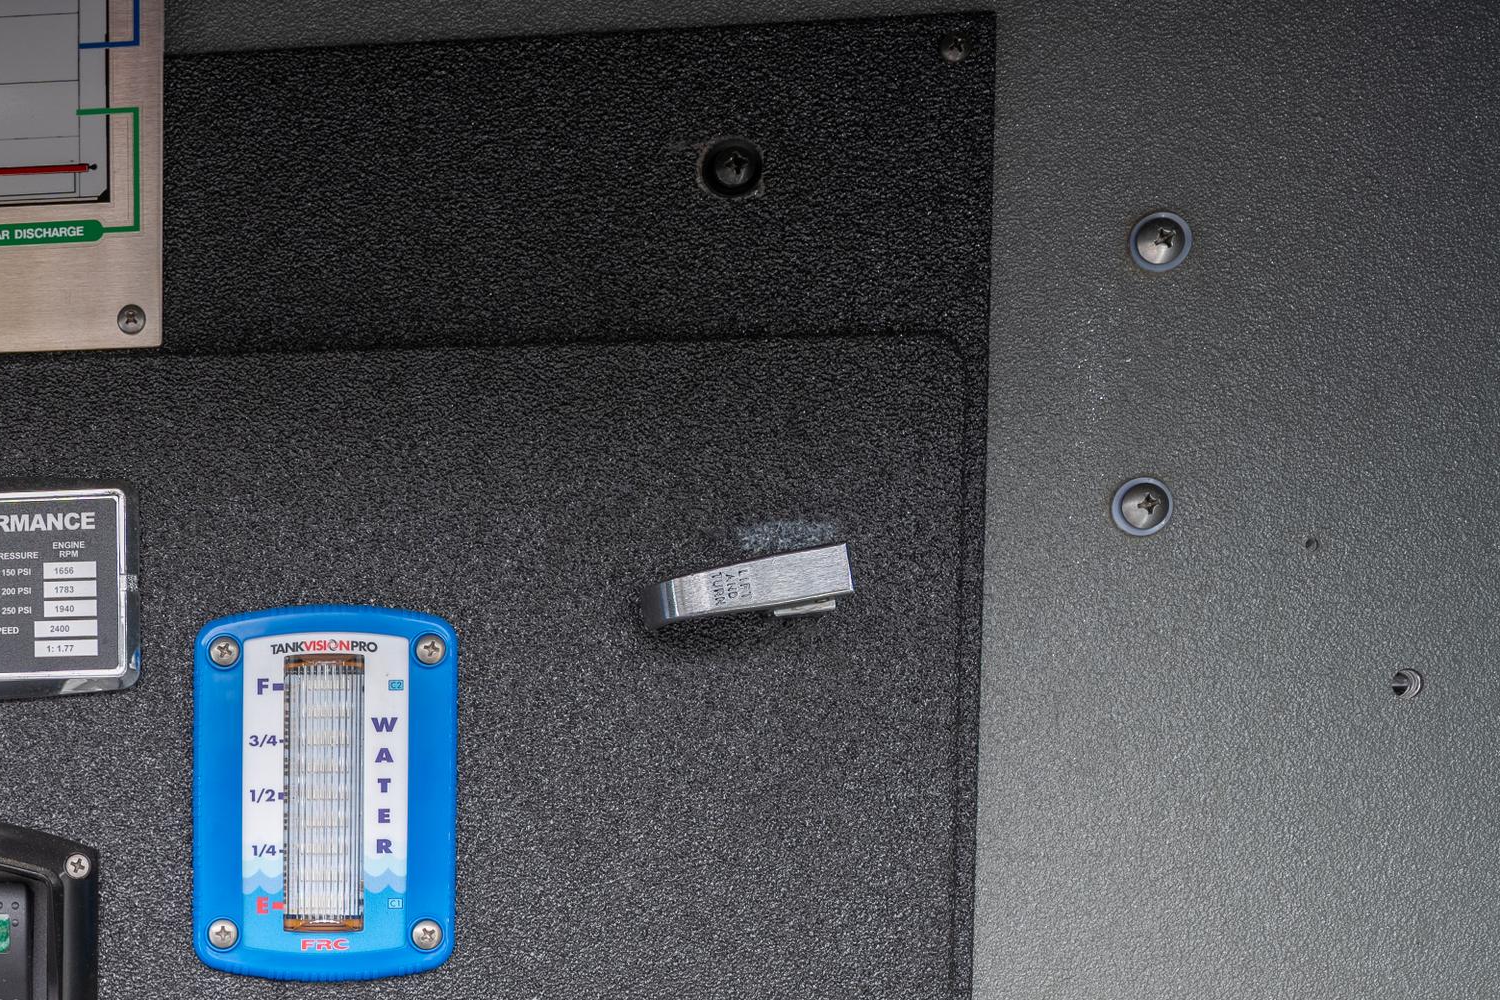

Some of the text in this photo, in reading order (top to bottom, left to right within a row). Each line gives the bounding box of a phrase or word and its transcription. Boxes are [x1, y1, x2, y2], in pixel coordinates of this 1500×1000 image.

[14, 227, 84, 239] DISCHARGE
[53, 541, 85, 549] ENGINE
[59, 550, 78, 558] RPM
[2, 568, 31, 577] 150 PSI
[54, 567, 74, 575] 1656
[271, 640, 378, 655] TANKVISIONPRO
[249, 735, 278, 748] 3/4
[372, 717, 398, 854] WATER
[252, 845, 277, 857] 1/4
[301, 939, 349, 950] FRC
